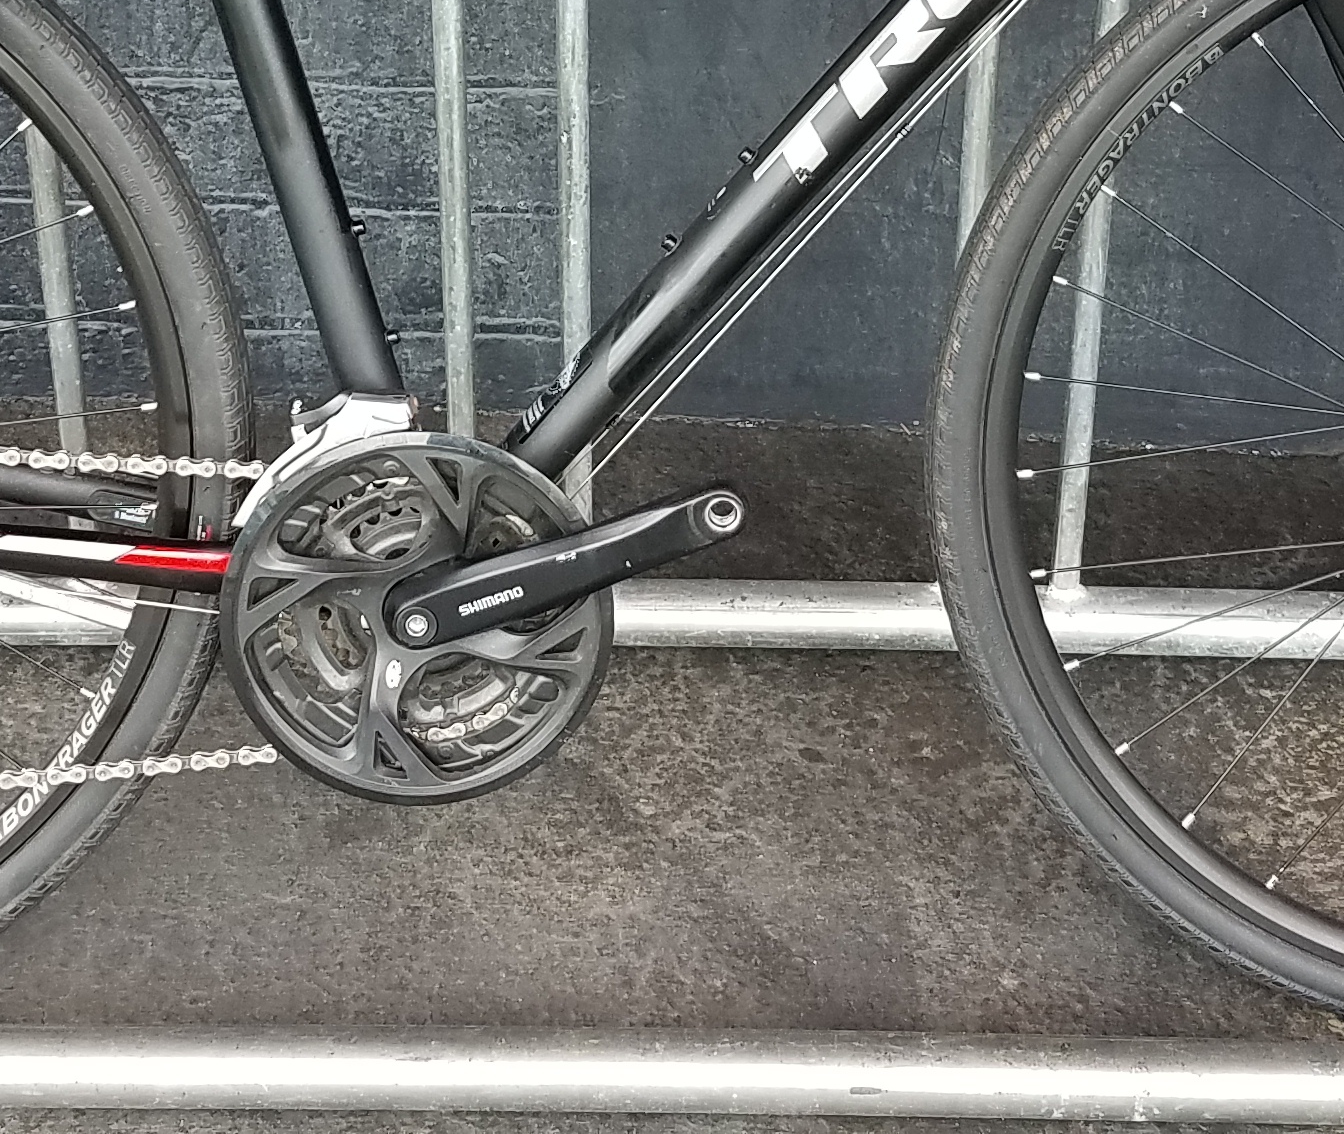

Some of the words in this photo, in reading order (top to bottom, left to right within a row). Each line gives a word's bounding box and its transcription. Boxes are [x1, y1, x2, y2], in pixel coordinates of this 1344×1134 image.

[1066, 60, 1205, 218] BONTRAGER
[1051, 214, 1077, 252] TLR
[458, 585, 524, 617] SHIMANO
[110, 640, 137, 678] TLR
